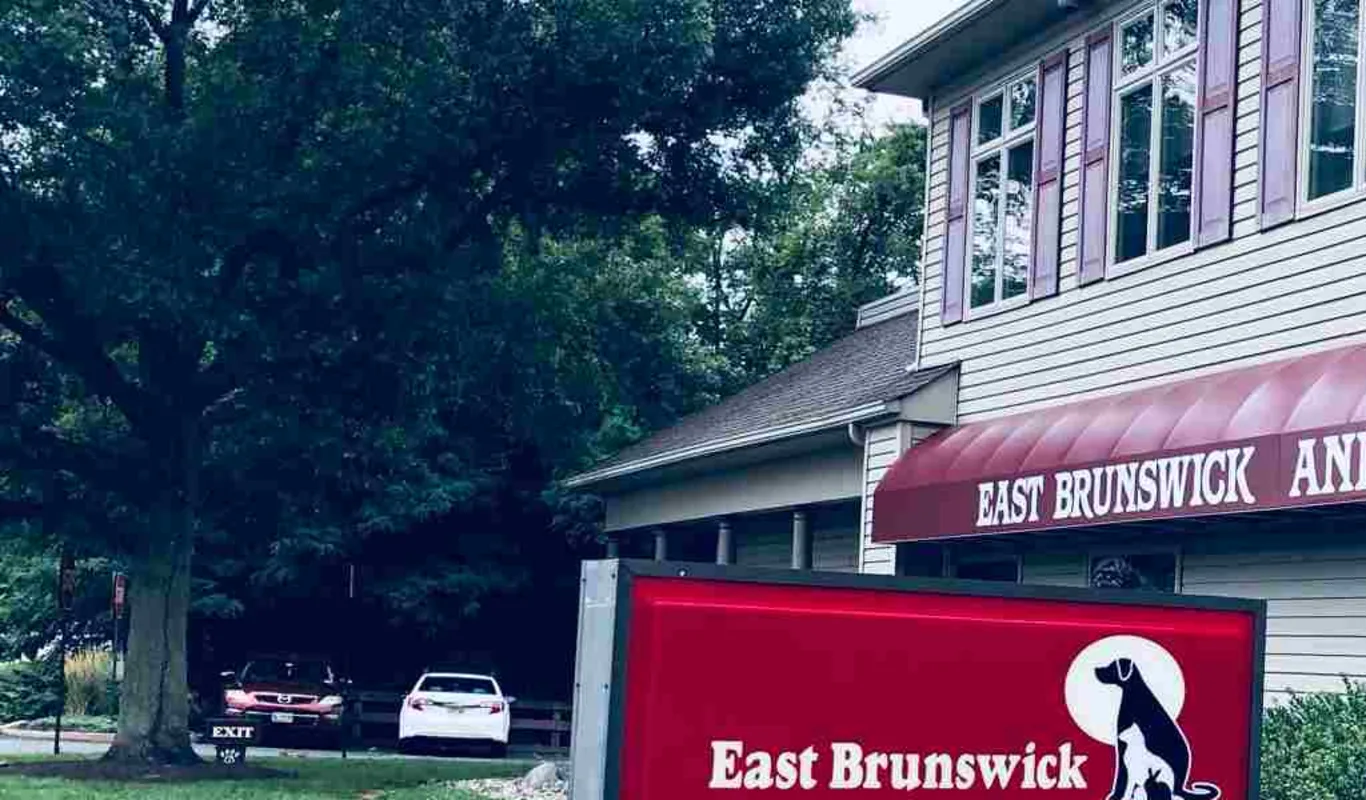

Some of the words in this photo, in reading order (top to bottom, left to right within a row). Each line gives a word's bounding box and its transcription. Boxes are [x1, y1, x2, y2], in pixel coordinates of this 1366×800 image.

[975, 474, 1044, 527] EAST
[1053, 446, 1256, 520] BRUNSWICK
[212, 726, 255, 738] EXIT
[708, 740, 819, 789] East
[828, 741, 1088, 791] Brunswick
